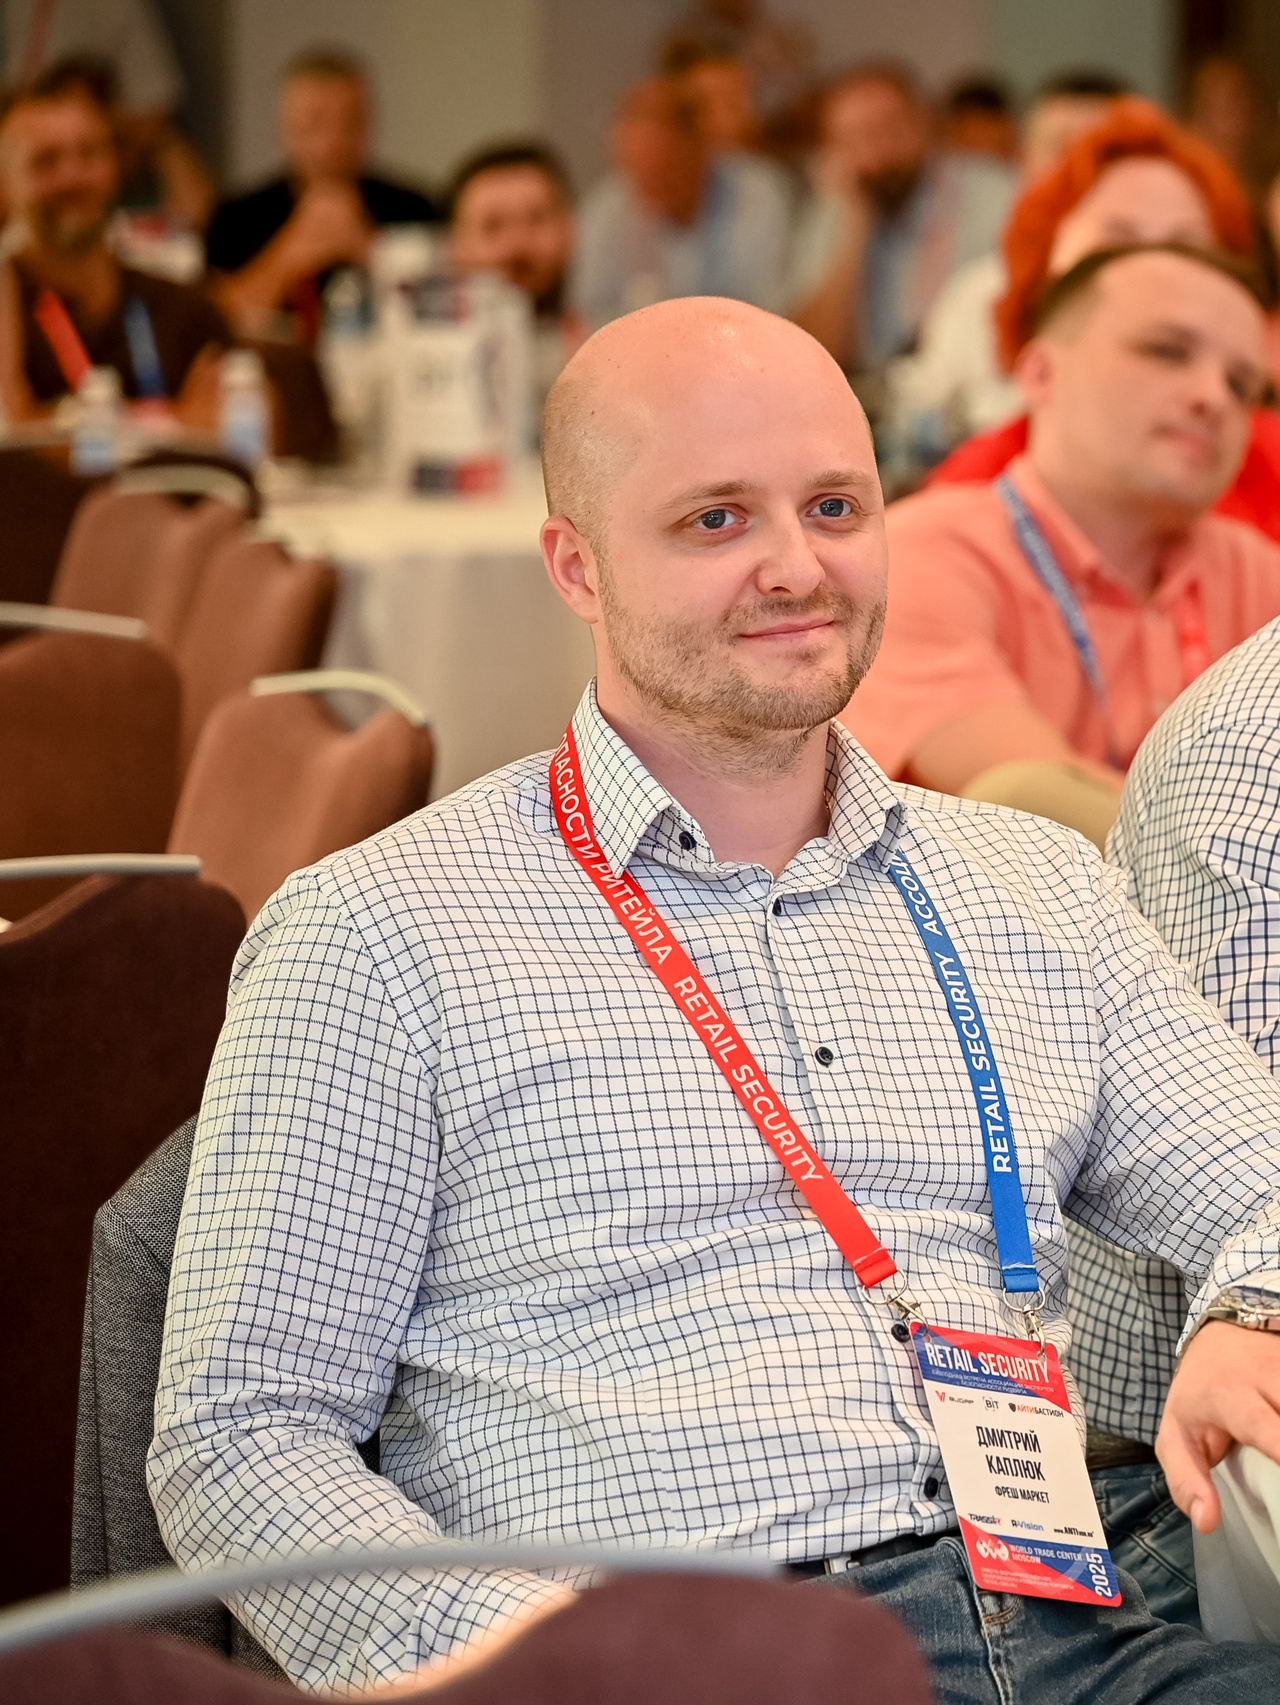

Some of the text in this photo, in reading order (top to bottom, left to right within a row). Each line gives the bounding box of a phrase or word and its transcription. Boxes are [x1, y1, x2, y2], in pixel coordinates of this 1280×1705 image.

[591, 862, 673, 965] РИТЕЙЛА
[673, 976, 739, 1063] RETAIL
[732, 1064, 824, 1182] SECURITY
[934, 951, 991, 1072] SECURITY
[978, 1077, 1013, 1174] RETAIL
[924, 1342, 1050, 1383] RETAIL SECURITY
[1017, 1405, 1064, 1418] АЙТИБАСТИОН
[976, 1425, 1042, 1454] ДМИТРИЙ
[985, 1454, 1046, 1481] КАПЛЮК
[995, 1485, 1050, 1504] ФРЕШ МАРКЕТ
[1009, 1544, 1083, 1561] WORLD TRADE CENTER
[1011, 1553, 1041, 1564] MOSCOW
[1085, 1553, 1113, 1598] 2025
